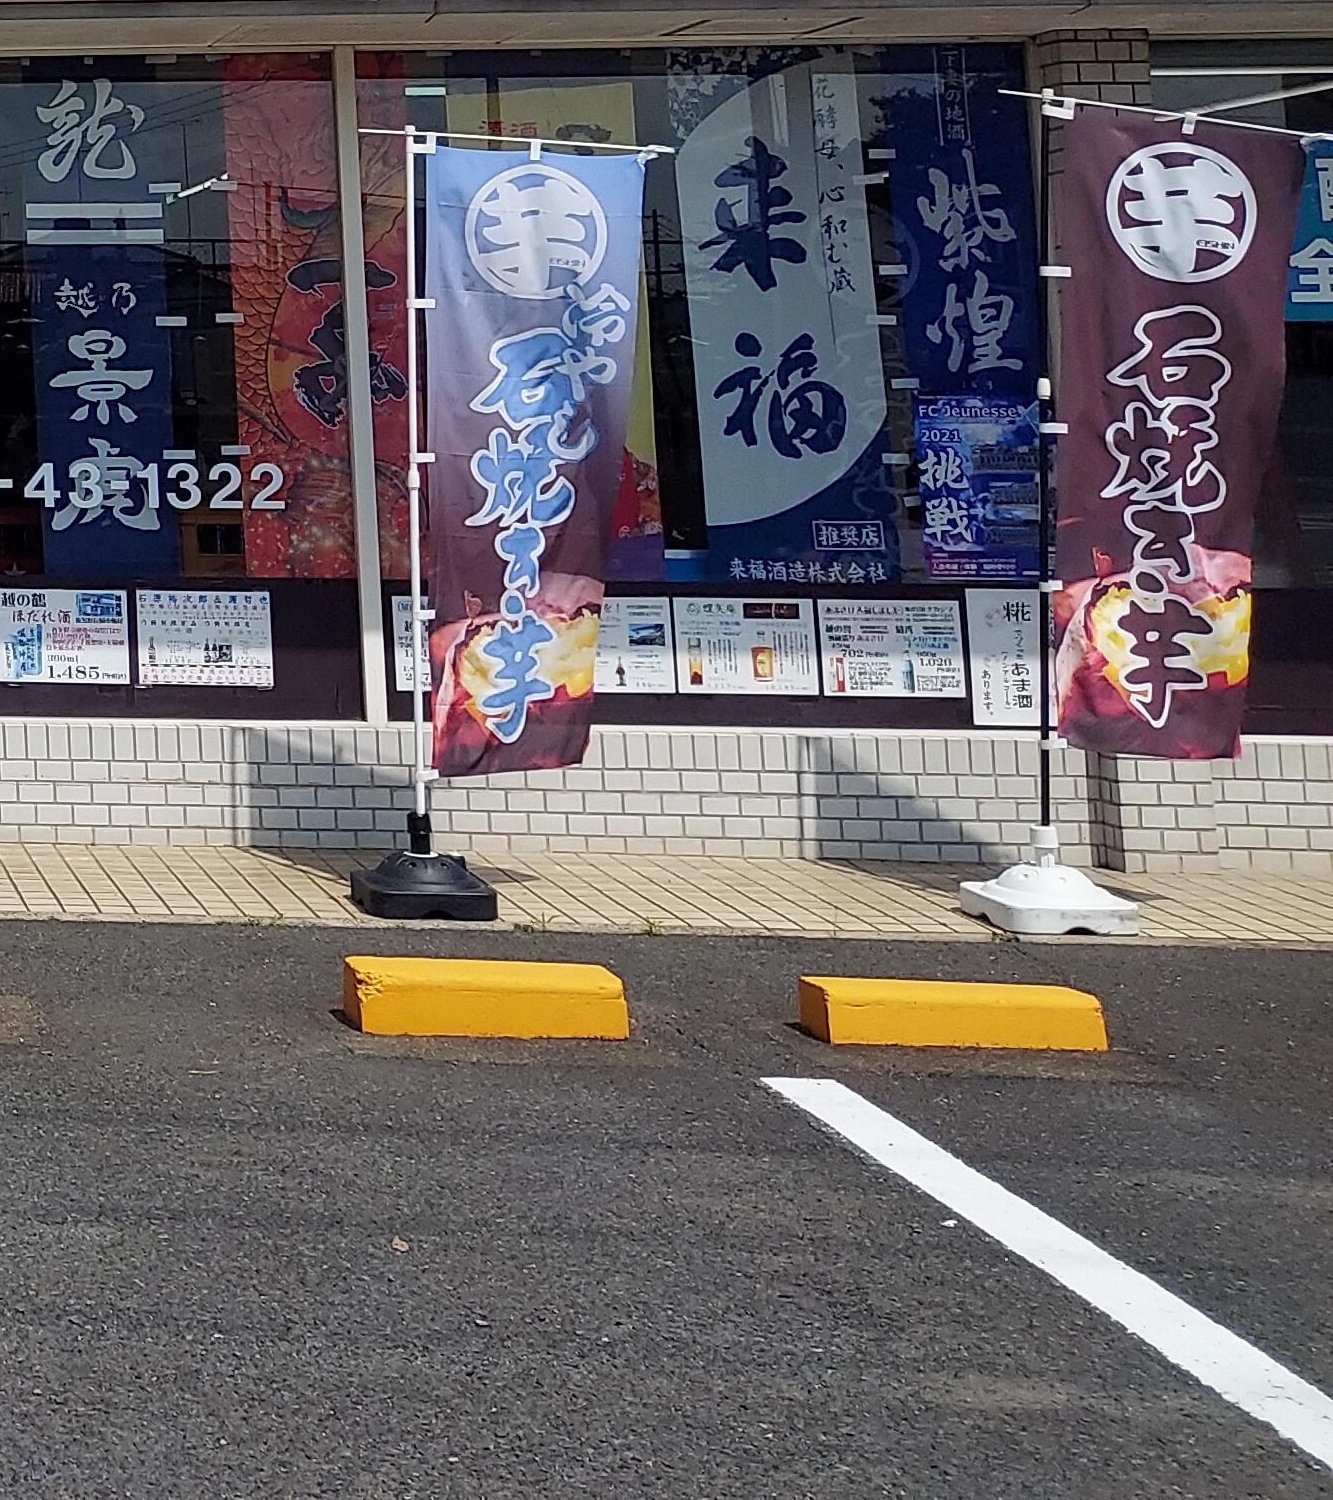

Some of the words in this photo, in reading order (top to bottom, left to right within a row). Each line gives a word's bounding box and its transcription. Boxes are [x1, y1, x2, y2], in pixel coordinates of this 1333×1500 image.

[699, 136, 847, 458] 来福
[546, 282, 631, 461] 冷やし
[944, 405, 1018, 418] Jeunesse
[921, 429, 962, 442] 2021
[464, 327, 575, 745] 石焼き芋
[818, 525, 880, 549] 推奨店
[918, 447, 973, 542] 挑戦
[1100, 304, 1231, 729] 石焼き芋
[728, 559, 887, 583] 来福酒造株式会社
